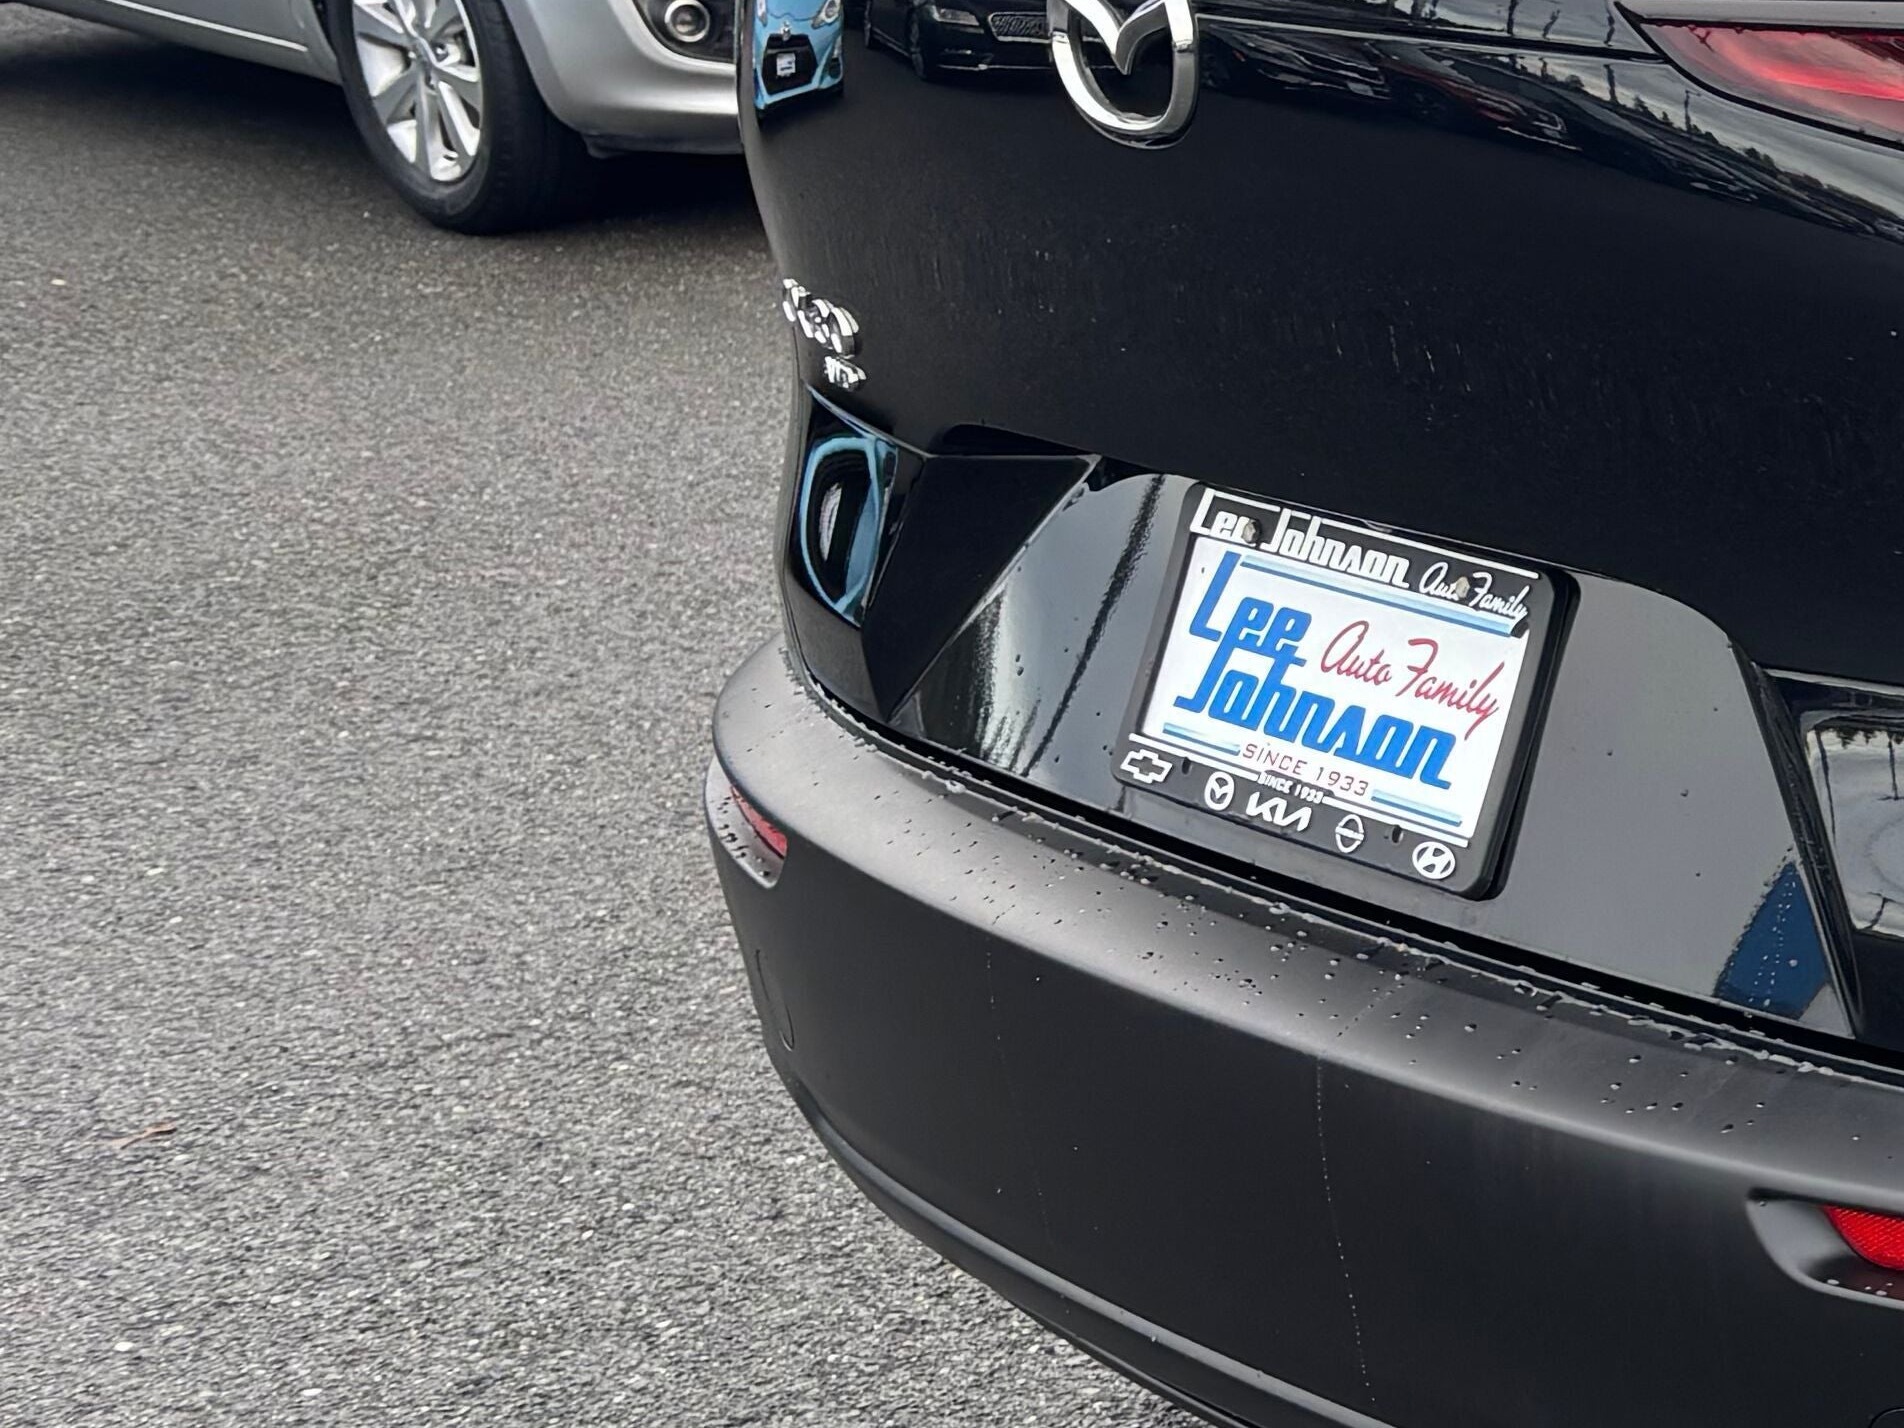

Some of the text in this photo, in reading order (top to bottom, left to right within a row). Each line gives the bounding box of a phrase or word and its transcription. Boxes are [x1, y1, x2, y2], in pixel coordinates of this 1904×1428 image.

[1260, 508, 1411, 588] Johnson
[1419, 562, 1470, 600] Aut
[1468, 572, 1530, 625] Family
[1189, 551, 1505, 741] Lee Auto Family
[1173, 642, 1457, 791] Johnson
[1241, 743, 1370, 798] SINCE 1933
[1258, 771, 1325, 804] SINCE 1933
